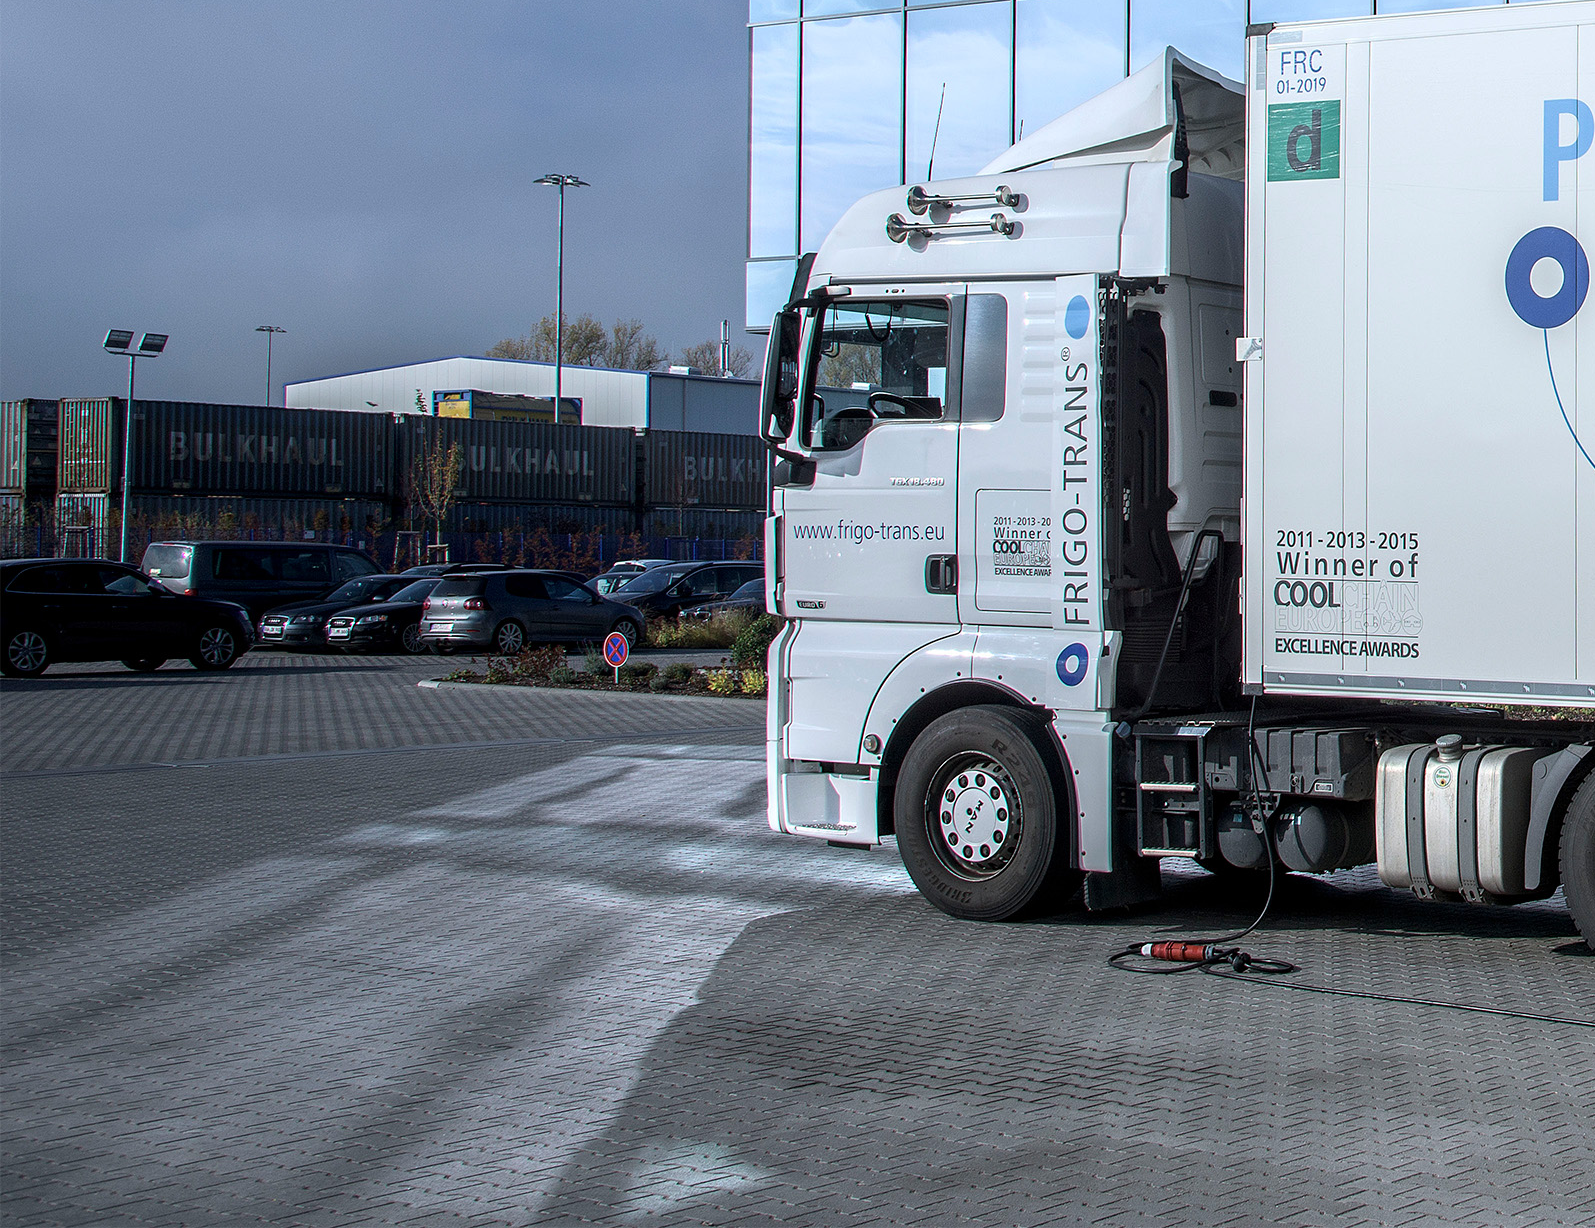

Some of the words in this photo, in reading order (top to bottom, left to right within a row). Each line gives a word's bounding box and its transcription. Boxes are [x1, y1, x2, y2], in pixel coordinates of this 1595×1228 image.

[1281, 49, 1322, 75] FRC
[1276, 77, 1327, 95] 01-2019
[1286, 109, 1322, 173] d
[169, 430, 345, 467] BULKHAUL
[793, 519, 945, 544] www.frigo-trans.eu
[993, 527, 1042, 539] Winner
[1276, 530, 1313, 548] 2011
[1326, 531, 1366, 548] 2013
[1378, 532, 1419, 550] 2015
[994, 567, 1034, 576] EXCELLENCE
[1276, 551, 1379, 577] Winner
[1389, 553, 1419, 578] of
[1274, 580, 1341, 608] COOL
[1275, 638, 1358, 656] EXCELLENCE
[1359, 641, 1420, 659] AWARDS
[964, 799, 984, 834] MAN
